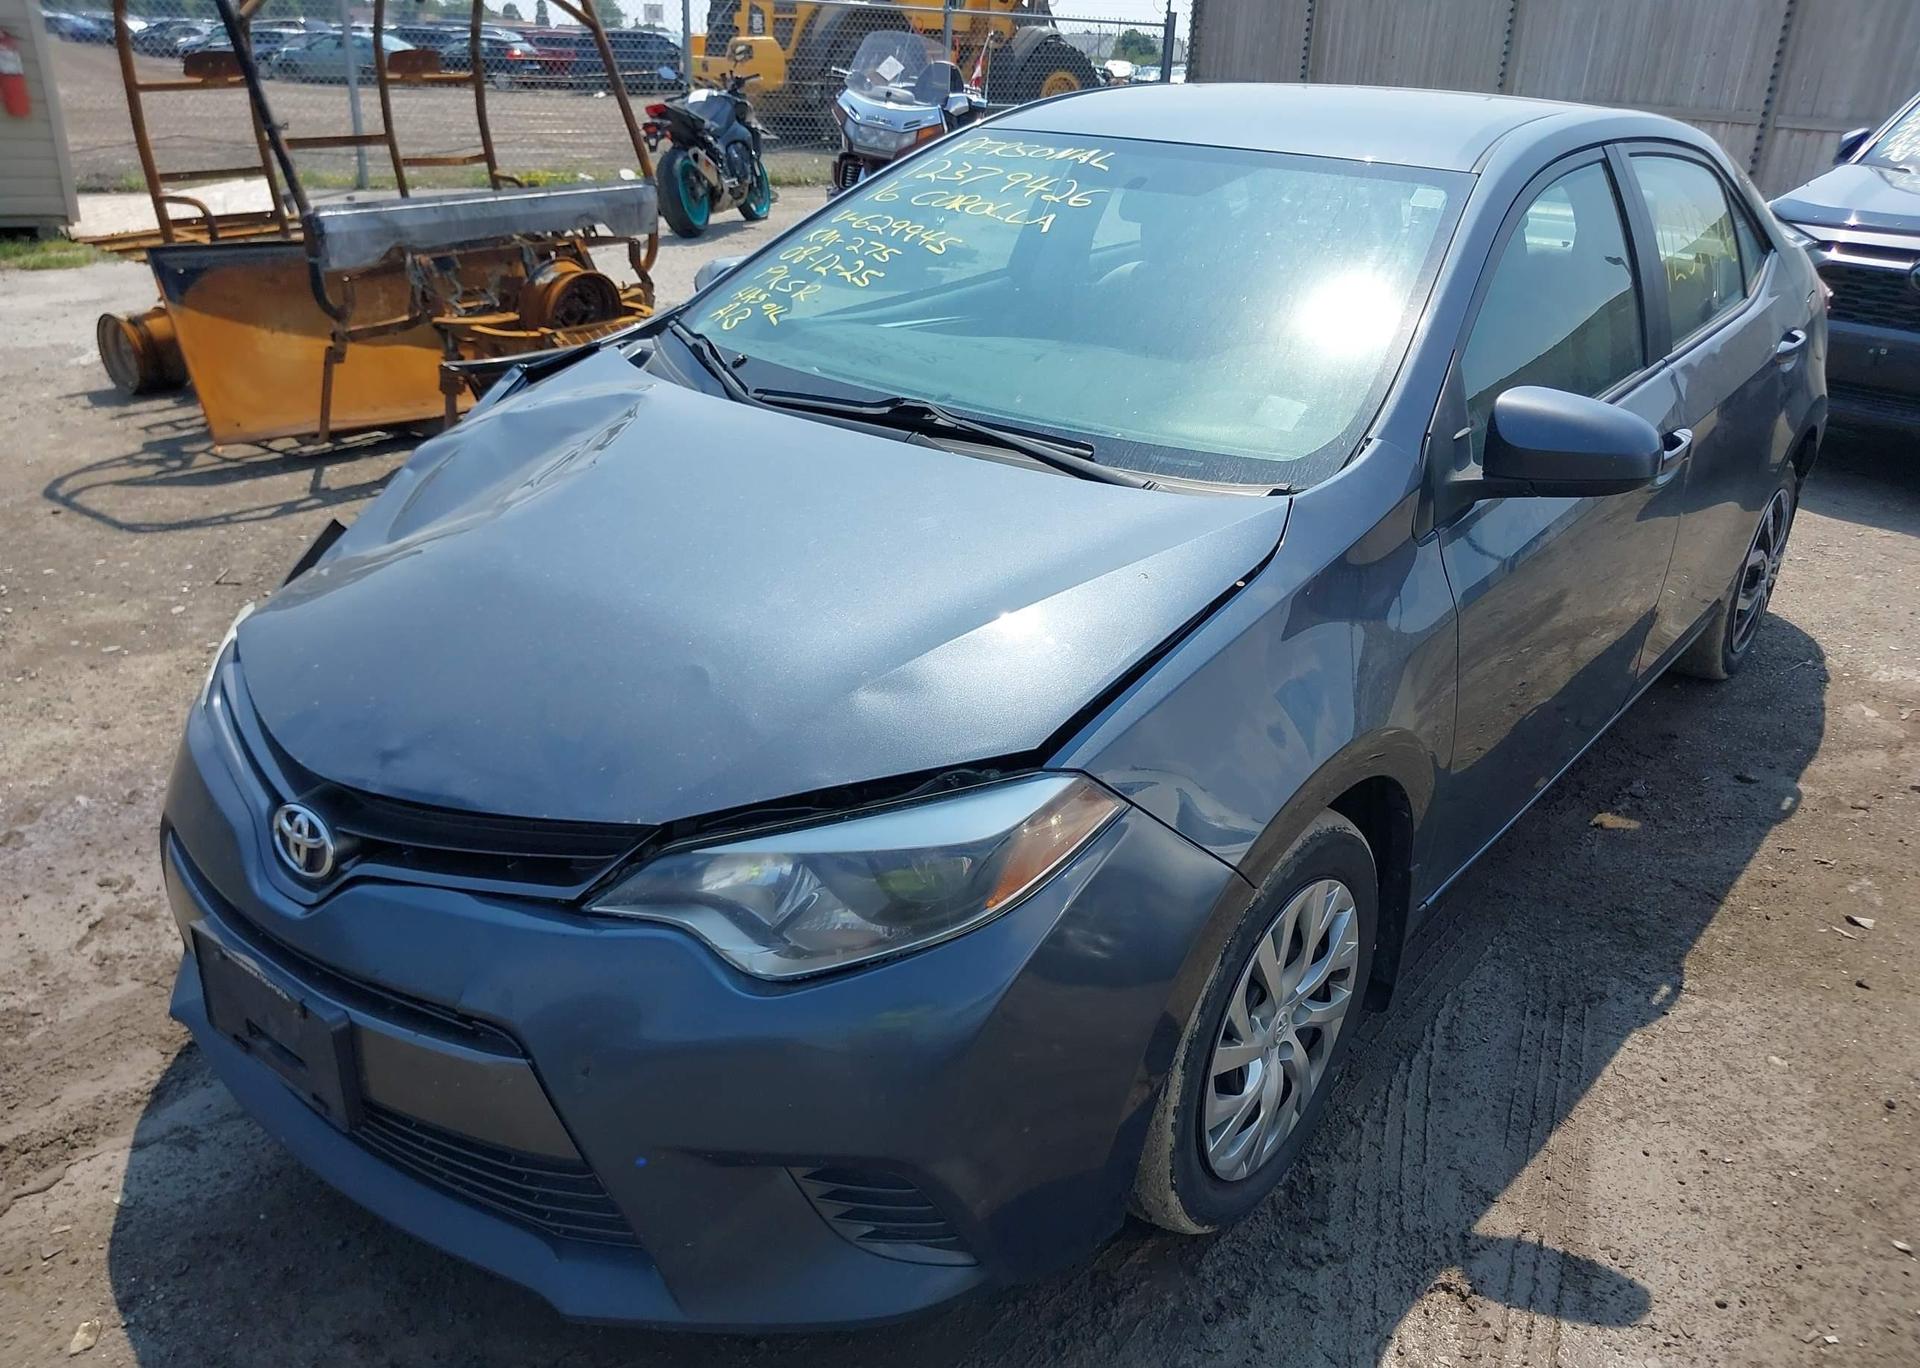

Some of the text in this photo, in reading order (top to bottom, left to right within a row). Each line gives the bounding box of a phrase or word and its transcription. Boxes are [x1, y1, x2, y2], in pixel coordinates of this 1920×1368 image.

[944, 136, 1116, 171] PERSONAL
[864, 180, 1057, 233] 16 COROLLA
[779, 246, 885, 287] 08-12-25
